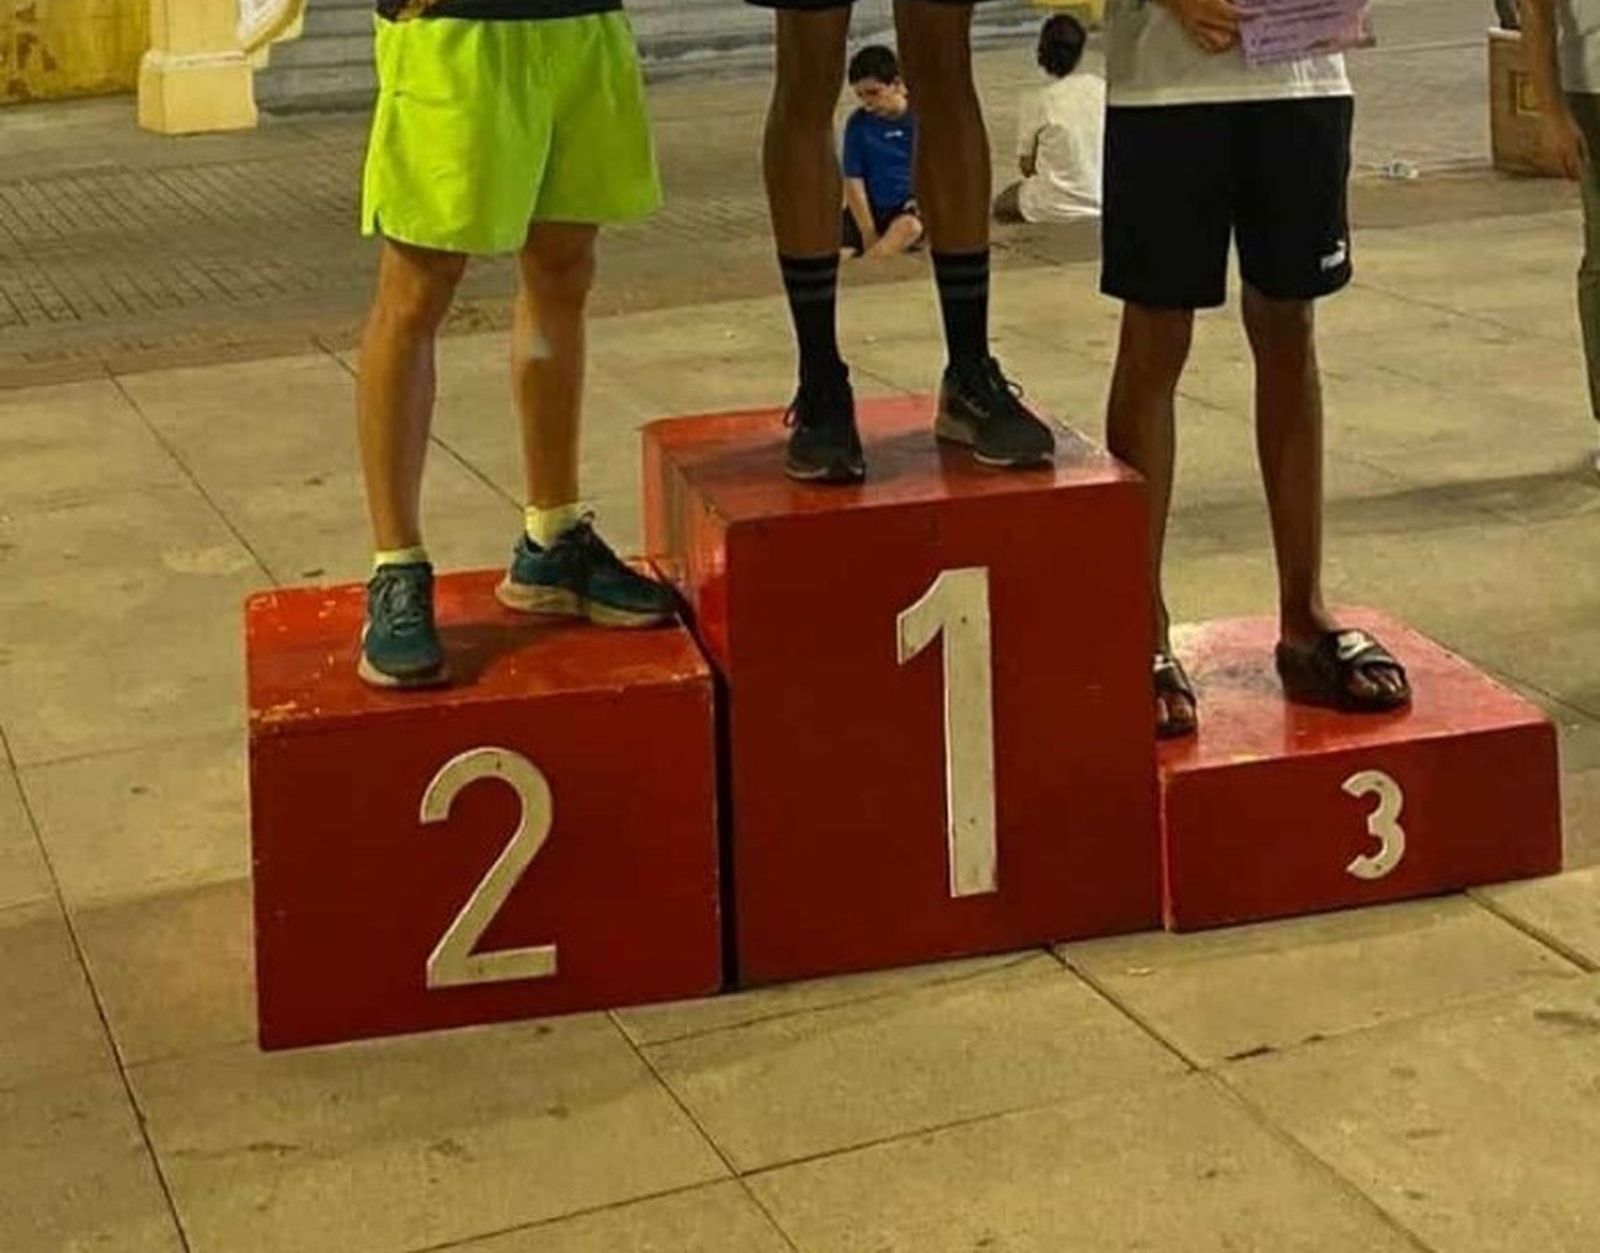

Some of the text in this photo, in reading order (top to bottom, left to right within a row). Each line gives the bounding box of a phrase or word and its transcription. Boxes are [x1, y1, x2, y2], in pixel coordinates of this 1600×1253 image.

[896, 566, 998, 898] 1
[1341, 770, 1406, 880] 3
[420, 747, 557, 989] 2
